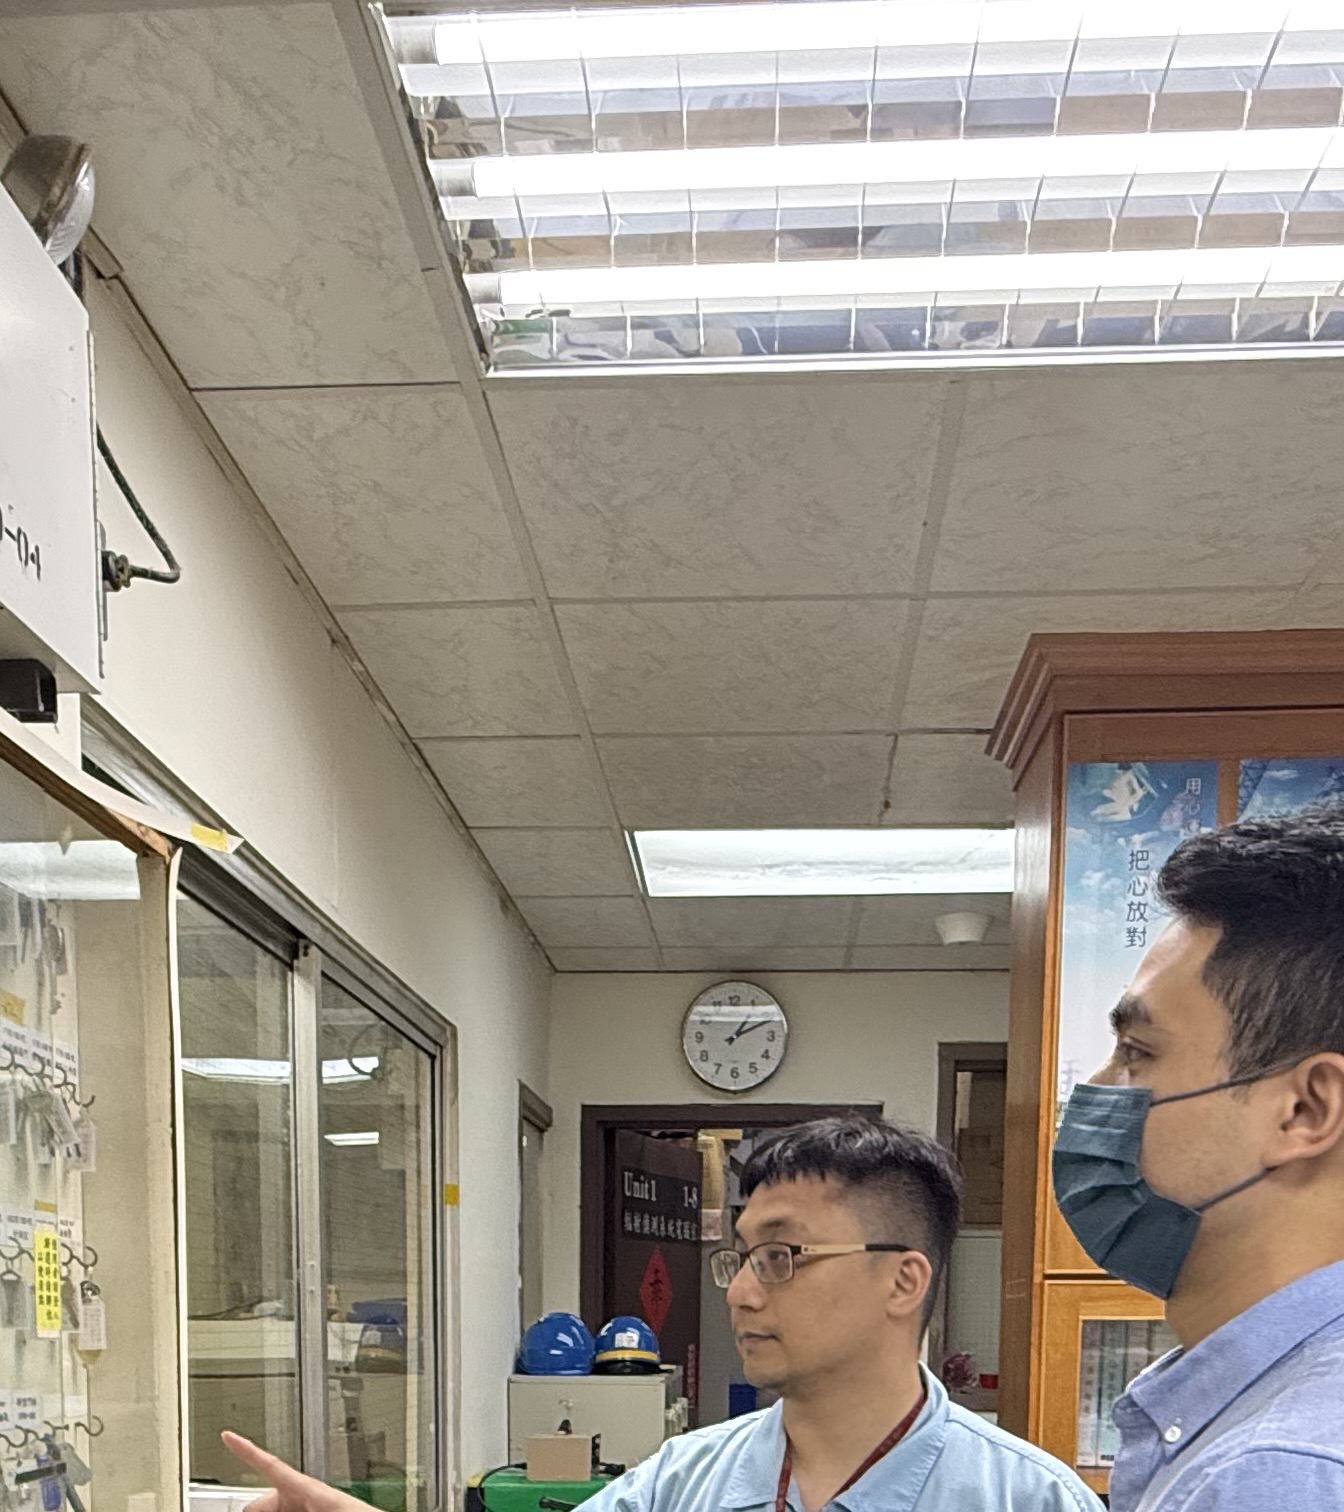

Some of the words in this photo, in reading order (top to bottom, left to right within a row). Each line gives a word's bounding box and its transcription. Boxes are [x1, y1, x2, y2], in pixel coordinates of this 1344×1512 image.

[1124, 850, 1150, 948] 把心放對
[728, 995, 741, 1006] 12
[695, 1031, 704, 1043] 9
[766, 1030, 776, 1042] 3
[699, 1050, 709, 1062] 8
[761, 1049, 771, 1060] 4
[714, 1063, 723, 1075] 7
[730, 1067, 740, 1079] 6
[749, 1062, 758, 1074] 5
[624, 1171, 649, 1200] Unit
